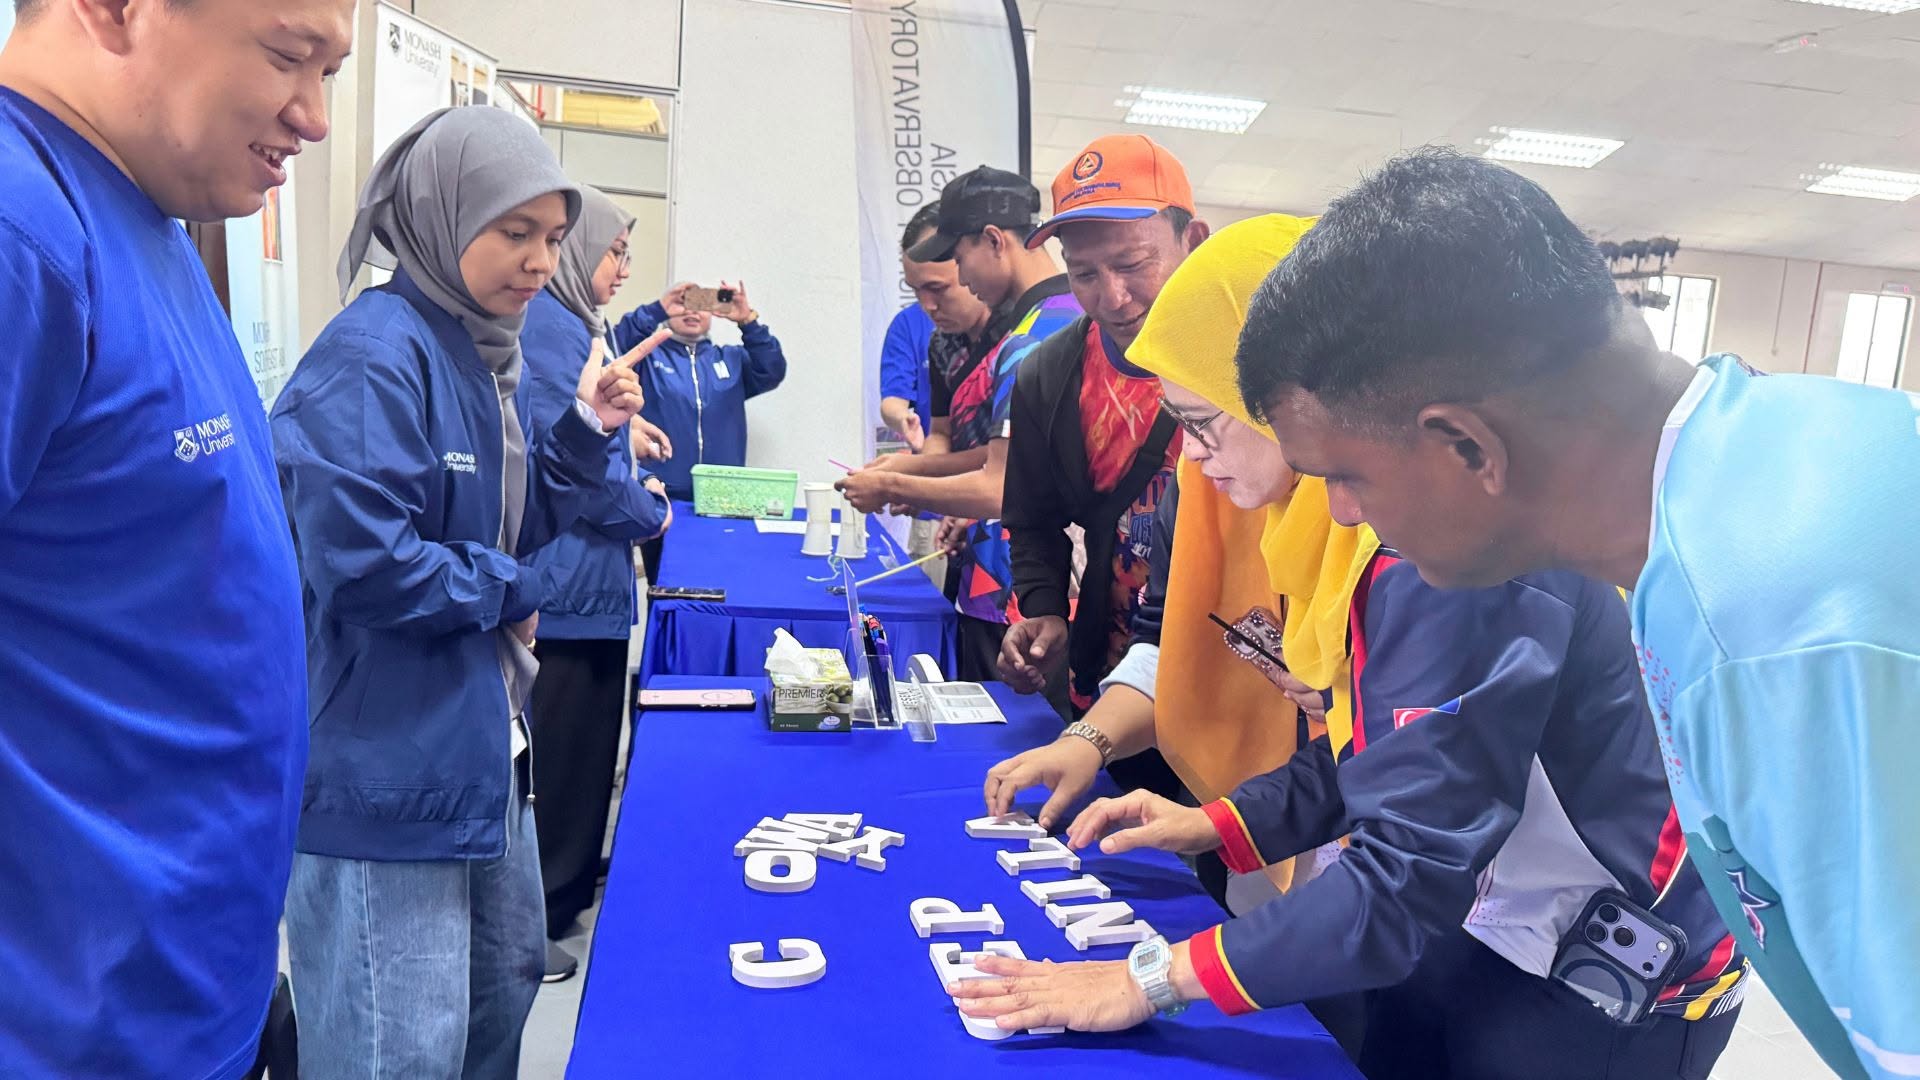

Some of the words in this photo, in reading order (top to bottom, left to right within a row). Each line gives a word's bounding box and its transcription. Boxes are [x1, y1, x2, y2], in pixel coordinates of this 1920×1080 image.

[404, 28, 441, 61] MONASH
[443, 451, 476, 464] MONAS
[778, 688, 825, 699] PREMIER
